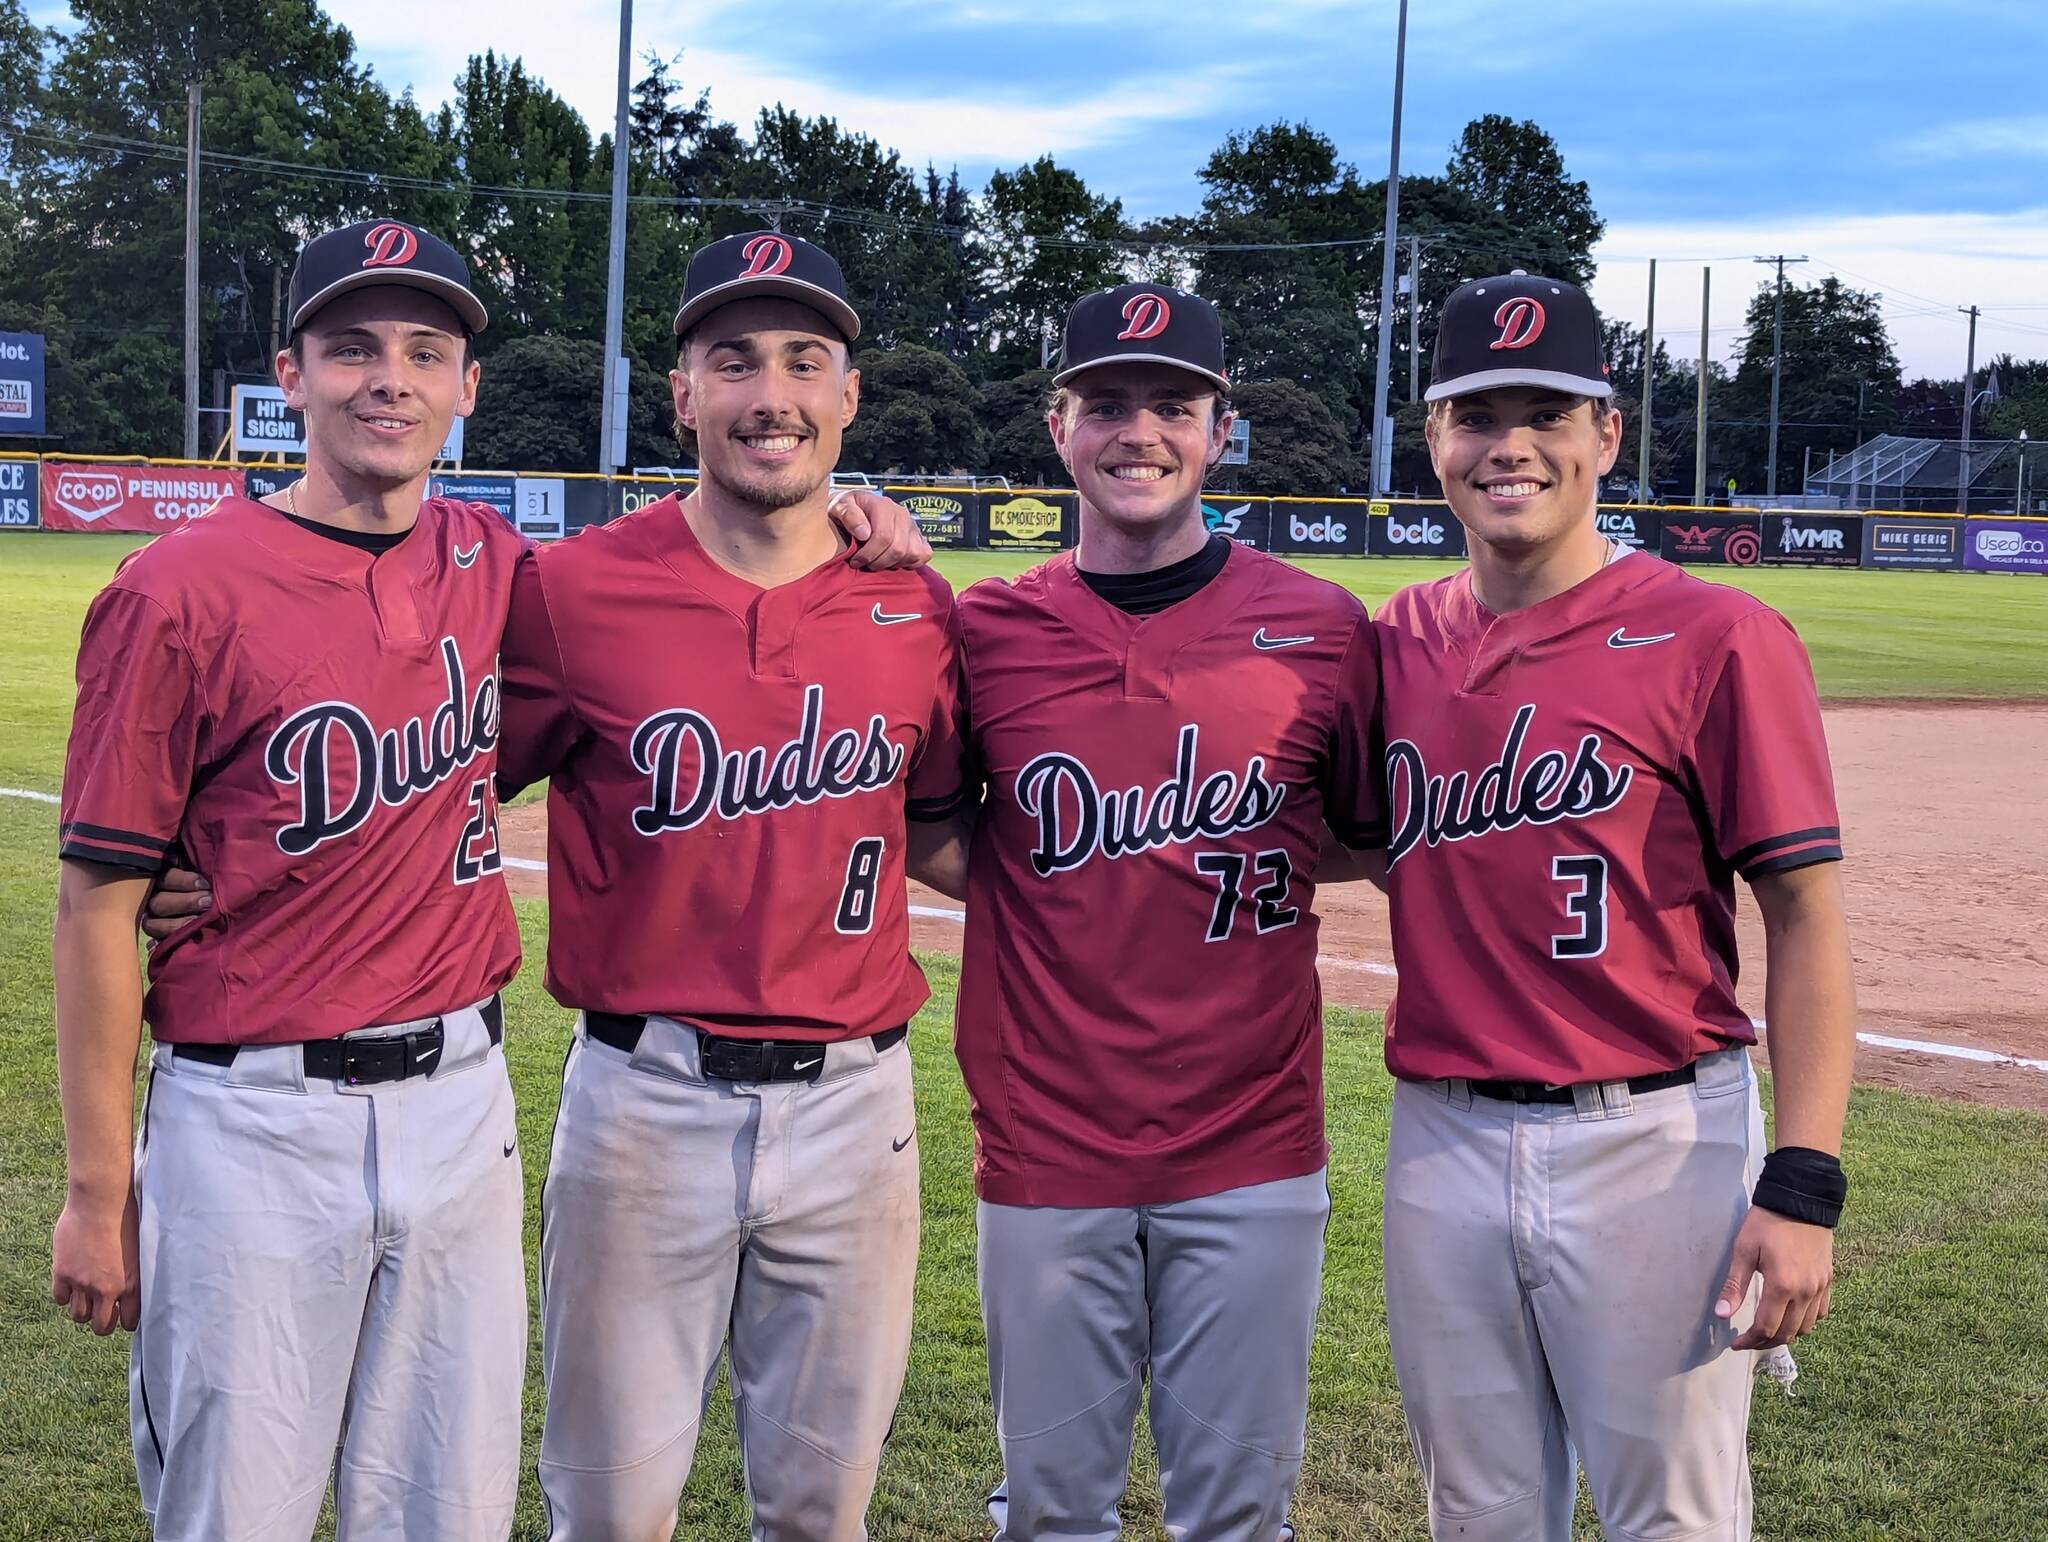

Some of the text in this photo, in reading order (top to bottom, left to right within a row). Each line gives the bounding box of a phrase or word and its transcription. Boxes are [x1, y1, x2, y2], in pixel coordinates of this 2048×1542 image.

[362, 223, 418, 267] D
[739, 235, 793, 279] D
[1117, 293, 1171, 340] D
[1489, 296, 1546, 349] D
[256, 400, 287, 418] HIT
[246, 419, 296, 439] SIGN!
[128, 480, 234, 499] PENINSULA
[251, 477, 276, 493] The
[0, 498, 31, 524] ES
[540, 491, 552, 516] 1
[1370, 505, 1387, 514] 400
[995, 510, 1058, 527] BC SMOKE SHOP
[1289, 514, 1347, 543] bclc
[1387, 516, 1444, 545] bclc
[1881, 533, 1948, 545] MIKE GERIC
[1978, 535, 2045, 553] Used.ca
[264, 635, 502, 856] Dude
[630, 683, 904, 837] Dudes
[1014, 723, 1287, 878] Dudes
[1385, 703, 1634, 874] Dudes
[834, 836, 885, 935] 8
[1194, 848, 1299, 943] 72
[1551, 854, 1608, 960] 3
